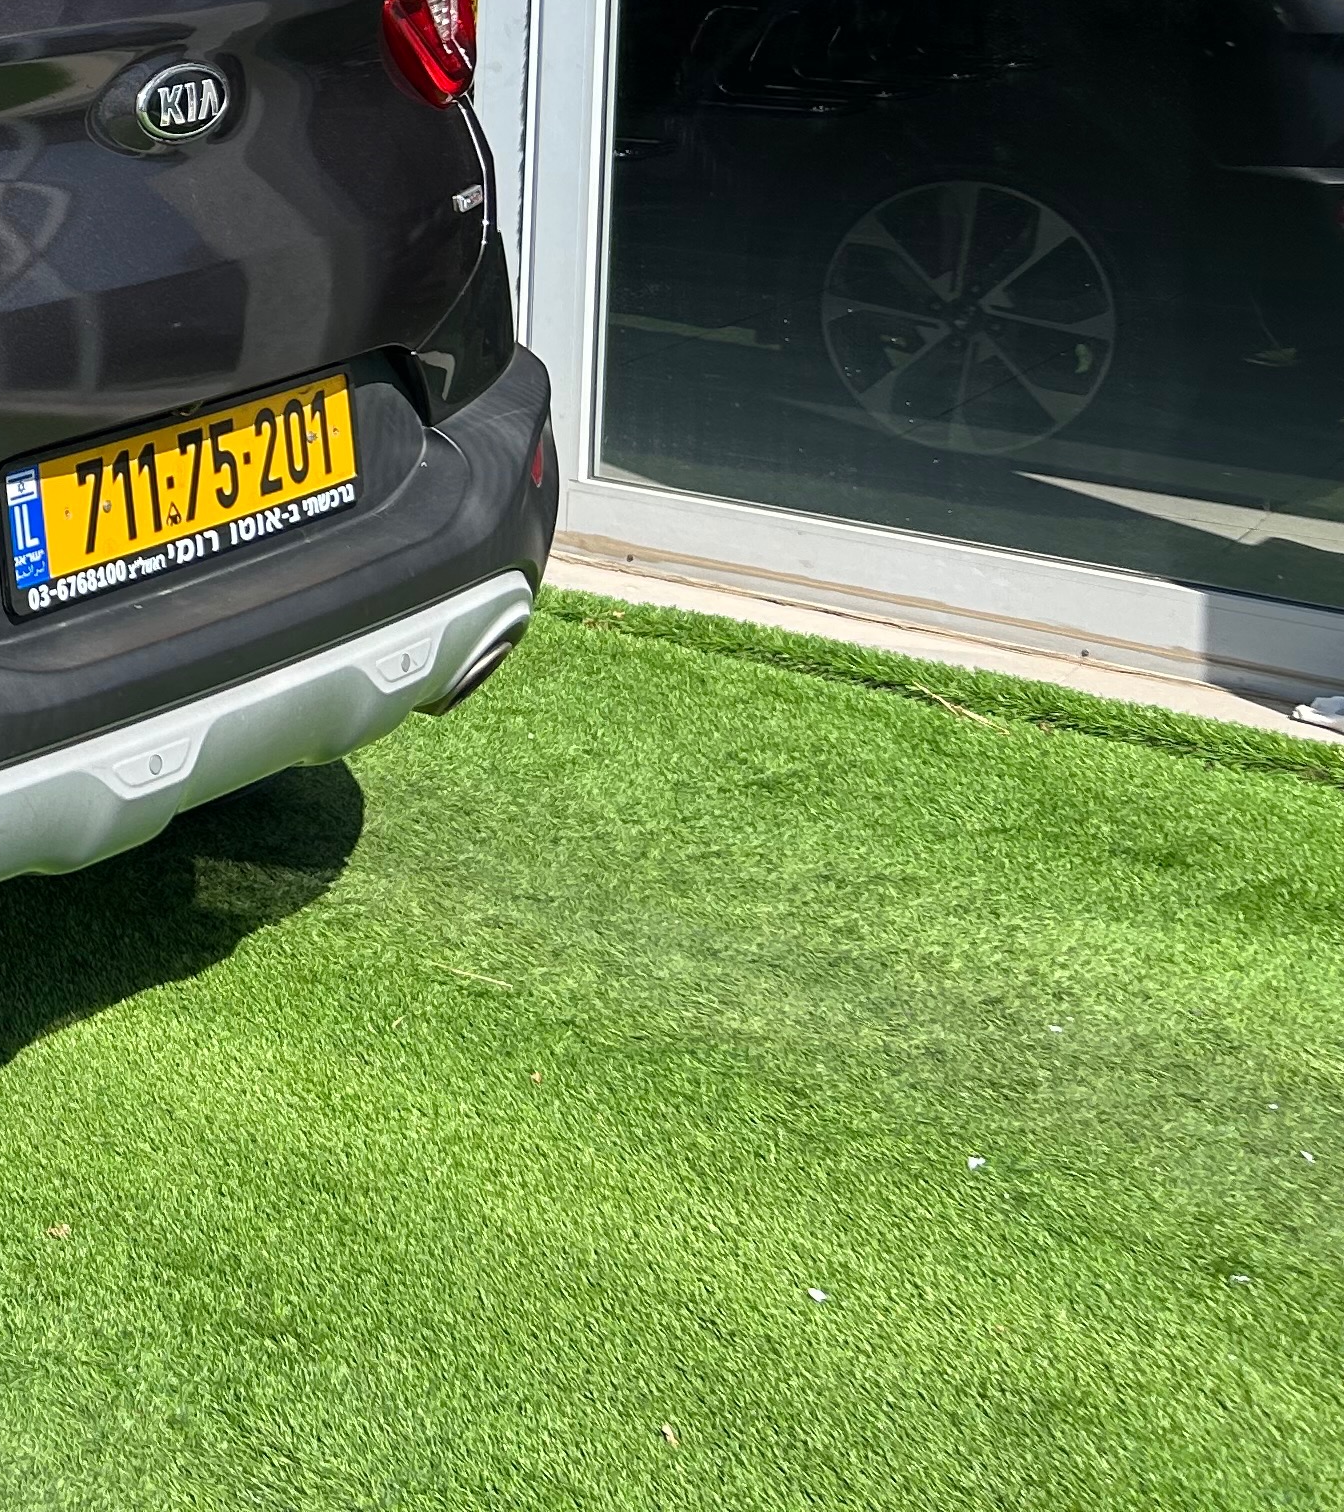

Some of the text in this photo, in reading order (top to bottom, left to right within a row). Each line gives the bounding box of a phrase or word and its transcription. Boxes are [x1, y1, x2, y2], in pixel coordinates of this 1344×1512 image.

[157, 78, 219, 127] KIA
[13, 503, 40, 551] IL
[167, 529, 220, 565] רומי
[27, 559, 127, 611] 03-6768100
